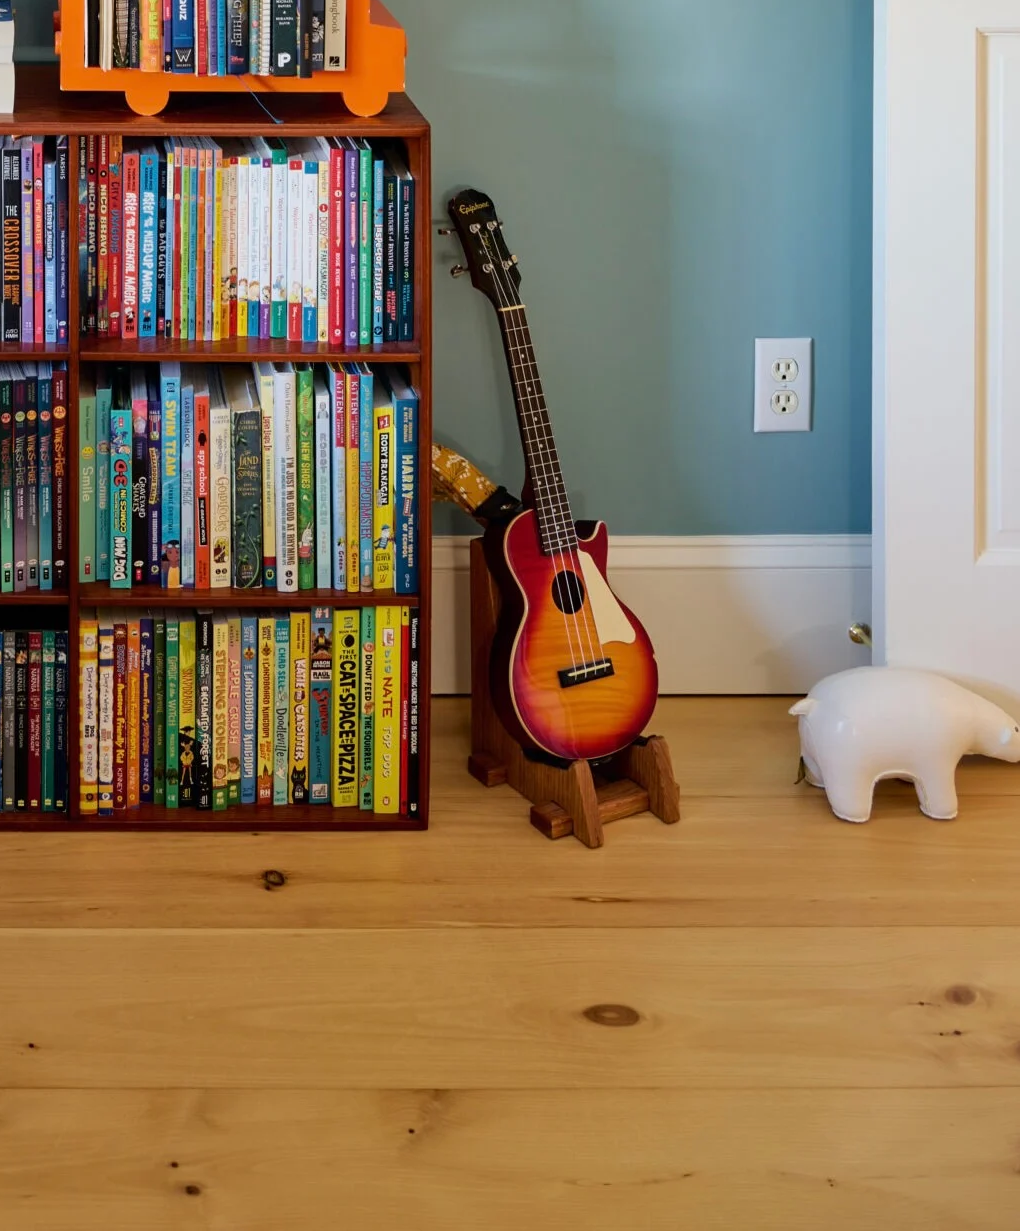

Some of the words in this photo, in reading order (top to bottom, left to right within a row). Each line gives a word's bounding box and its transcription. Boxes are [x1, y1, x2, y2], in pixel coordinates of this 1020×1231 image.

[231, 12, 242, 46] THIEF
[6, 205, 17, 216] THE
[459, 201, 489, 215] Epiphone
[319, 216, 327, 236] DORY
[4, 219, 19, 281] CROSSOVER
[320, 250, 328, 301] FANTASMAGORY
[336, 380, 344, 413] KITTEN
[166, 400, 176, 436] SWIM
[166, 441, 176, 476] TEAM
[286, 457, 294, 469] I'M
[302, 441, 310, 461] NEW
[82, 467, 93, 502] Smile
[115, 460, 127, 487] 3-D
[199, 467, 207, 496] school
[286, 471, 294, 488] JUST
[302, 463, 310, 488] SHOES
[380, 459, 388, 504] BRANAGAN
[402, 455, 413, 498] HARRY
[100, 479, 108, 509] Smile
[120, 490, 127, 499] IN
[138, 477, 147, 518] GRAVEYARD
[286, 490, 294, 500] NO
[119, 501, 127, 533] COMICS
[286, 502, 294, 522] GOOD
[287, 524, 294, 532] AT
[402, 523, 408, 531] OF
[113, 536, 126, 556] MAN
[113, 557, 126, 581] DOG
[278, 648, 286, 668] CHAD
[182, 668, 192, 714] SNAPDRAGON
[215, 650, 226, 709] STEPPING
[229, 658, 240, 699] APPLE
[278, 671, 286, 688] SELL
[340, 661, 356, 689] CAT
[200, 687, 209, 731] ENCHANTED
[244, 672, 254, 730] CARDBOARD
[383, 677, 392, 718] NATE
[229, 707, 240, 744] CRUSH
[339, 694, 356, 737] SPACE
[215, 713, 226, 761] STONES
[276, 708, 287, 757] Doodleville
[383, 727, 391, 748] TOP
[201, 733, 209, 768] FOREST
[244, 734, 253, 778] KINGDOM
[338, 744, 355, 786] PIZZA
[364, 730, 372, 771] SQUIRRELS
[383, 753, 391, 778] DOG
